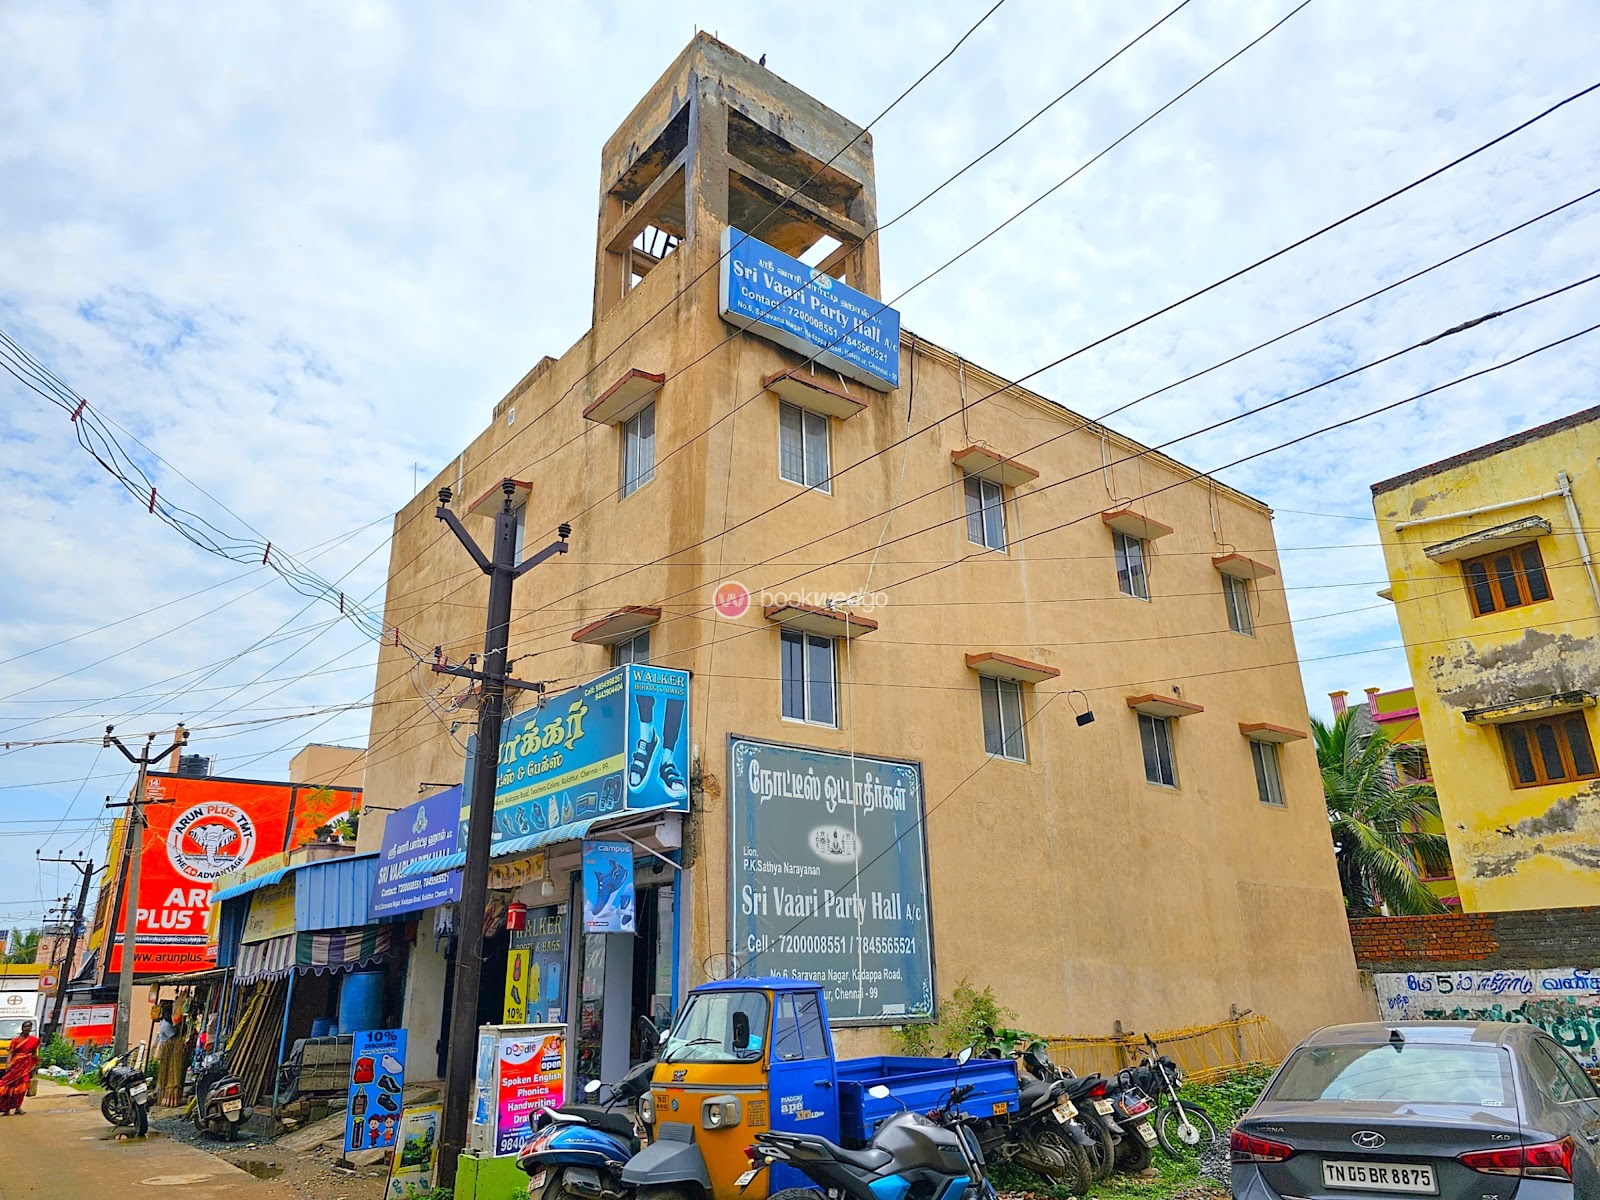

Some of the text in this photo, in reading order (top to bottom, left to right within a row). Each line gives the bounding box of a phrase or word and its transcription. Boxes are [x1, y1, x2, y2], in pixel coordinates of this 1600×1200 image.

[733, 260, 758, 283] Sri
[763, 272, 805, 304] Vaari
[811, 295, 849, 328] Party
[853, 317, 881, 343] Hall
[741, 286, 780, 310] Contact
[842, 333, 888, 364] 7845565521
[633, 669, 685, 687] WALKER
[749, 759, 821, 805] நோட்டீஸ்
[175, 805, 253, 838] ARUN PLUS TMT
[598, 845, 631, 853] campus
[174, 854, 187, 869] THE
[197, 856, 245, 878] ADVANTAGE
[743, 859, 820, 877] P.K.Sathya Narayanan
[742, 884, 767, 916] Sri
[773, 886, 818, 917] Vaari
[824, 889, 866, 925] Party
[871, 891, 902, 920] Hall
[747, 934, 768, 952] Cell
[779, 935, 847, 954] 7200008551
[855, 936, 916, 954] 7845565521
[791, 969, 825, 981] Saravana
[827, 969, 850, 984] Nagar,
[852, 968, 883, 984] Kadappa
[883, 968, 902, 981] Road,
[1436, 975, 1453, 994] 5
[834, 988, 864, 1000] Chennai
[870, 987, 878, 999] 99
[508, 1008, 523, 1019] 10%
[367, 1030, 397, 1042] 10%
[542, 1060, 561, 1070] open
[502, 1075, 531, 1087] Spoken
[533, 1071, 562, 1083] English
[517, 1086, 549, 1097] Phonics
[507, 1098, 556, 1112] Handwriting
[1326, 1165, 1430, 1186] TN 05 BR 8875
